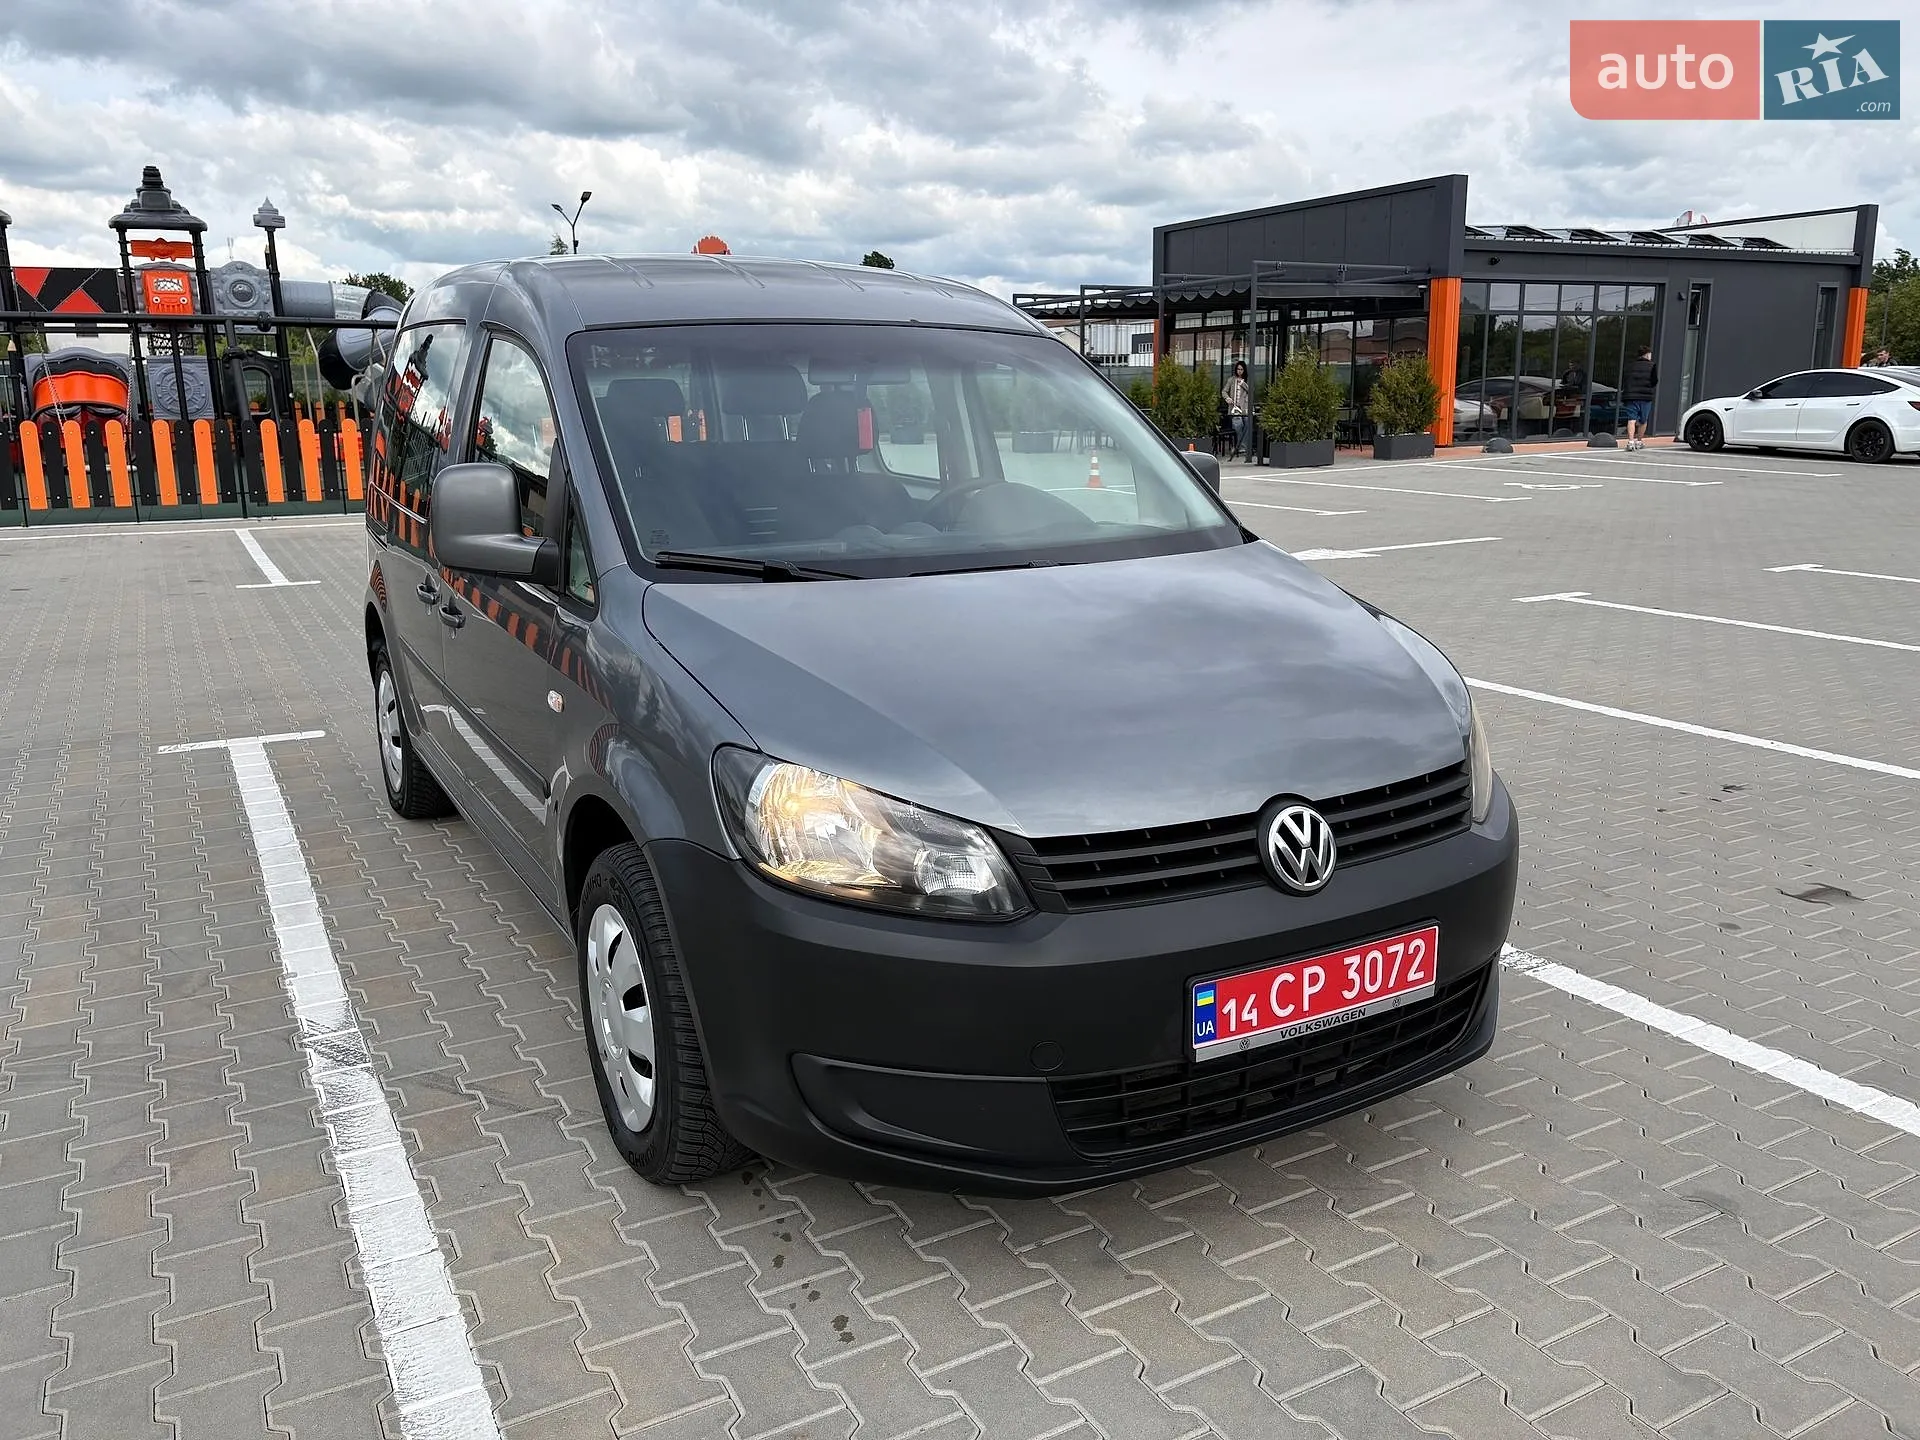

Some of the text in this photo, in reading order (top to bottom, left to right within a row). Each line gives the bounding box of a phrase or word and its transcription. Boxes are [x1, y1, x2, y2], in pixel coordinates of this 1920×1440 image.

[1221, 938, 1426, 1032] 14 CP 3072
[1196, 1020, 1215, 1037] UA
[1280, 1007, 1367, 1039] VOLKSWAGEN
